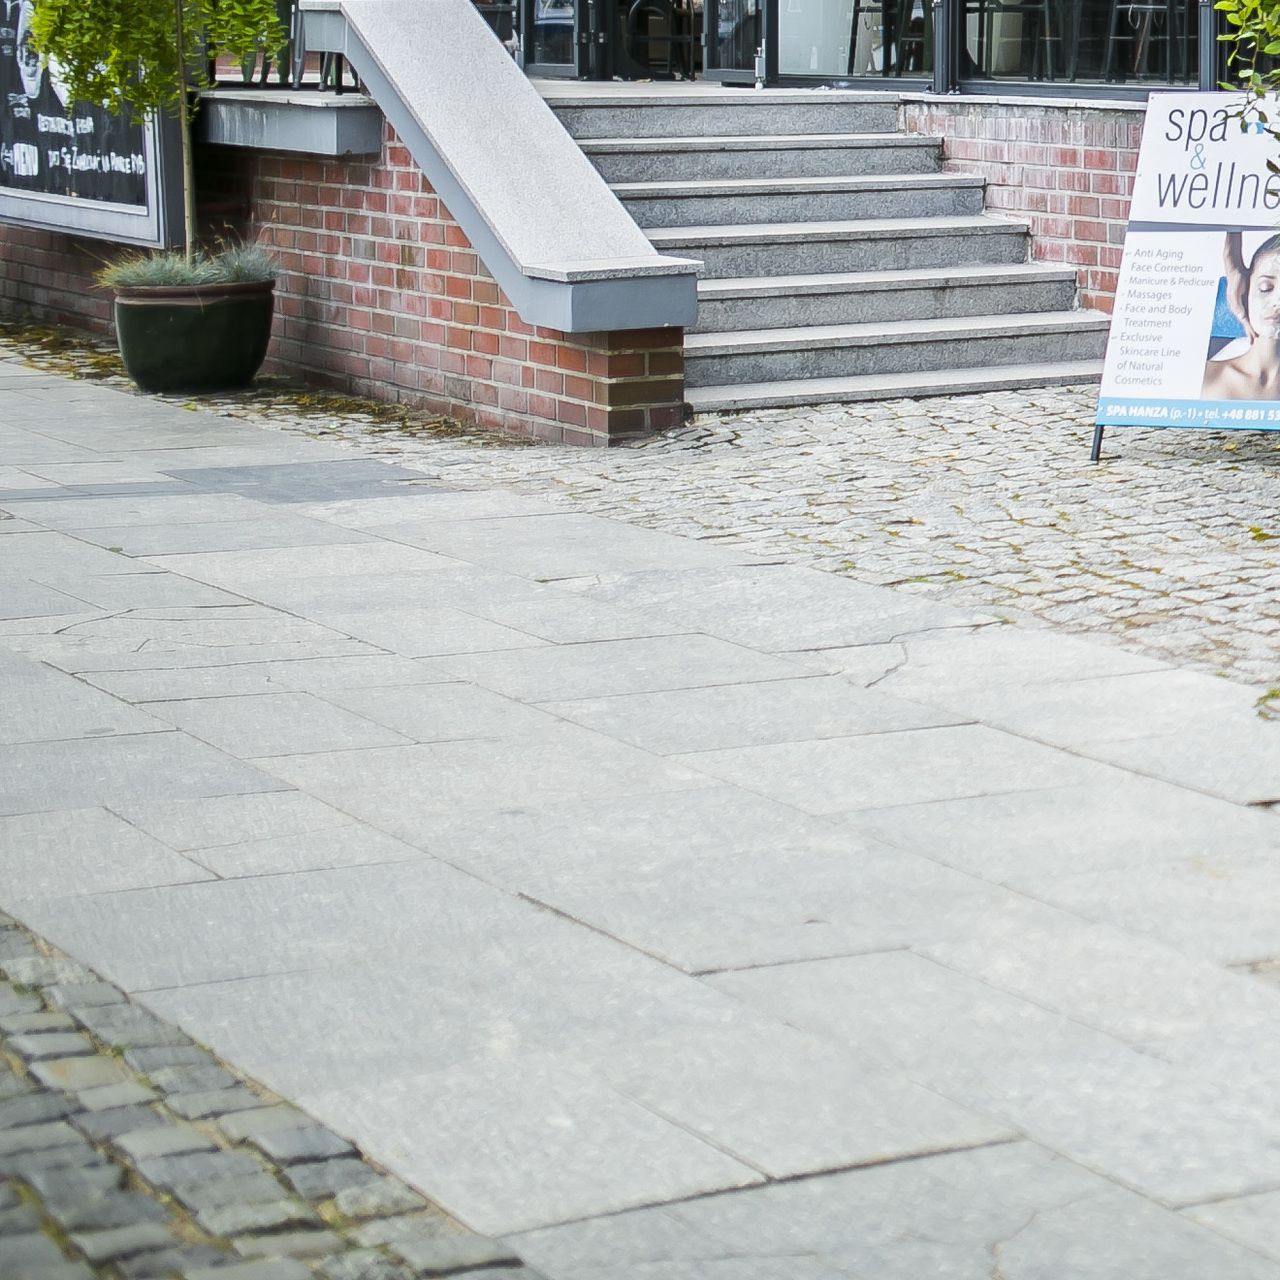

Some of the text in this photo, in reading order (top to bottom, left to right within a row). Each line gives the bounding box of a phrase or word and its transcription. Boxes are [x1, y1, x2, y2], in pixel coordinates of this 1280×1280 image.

[1165, 108, 1229, 151] spa
[1190, 143, 1206, 170] &
[1134, 249, 1183, 261] Anti Aging
[1131, 263, 1203, 273] Face Correction
[1129, 276, 1168, 286] Manicure
[1178, 277, 1215, 287] Pedicure
[1127, 290, 1172, 301] Massages
[1125, 303, 1192, 317] Face and Body
[1124, 318, 1172, 328] Treatment
[1120, 332, 1163, 342] Exclusive
[1120, 347, 1181, 358] Skincare Line
[1117, 361, 1163, 371] of Natural
[1115, 375, 1162, 386] Cosmetics
[1106, 405, 1126, 416] SPA
[1128, 405, 1168, 417] HANZA
[1222, 408, 1242, 420] +48
